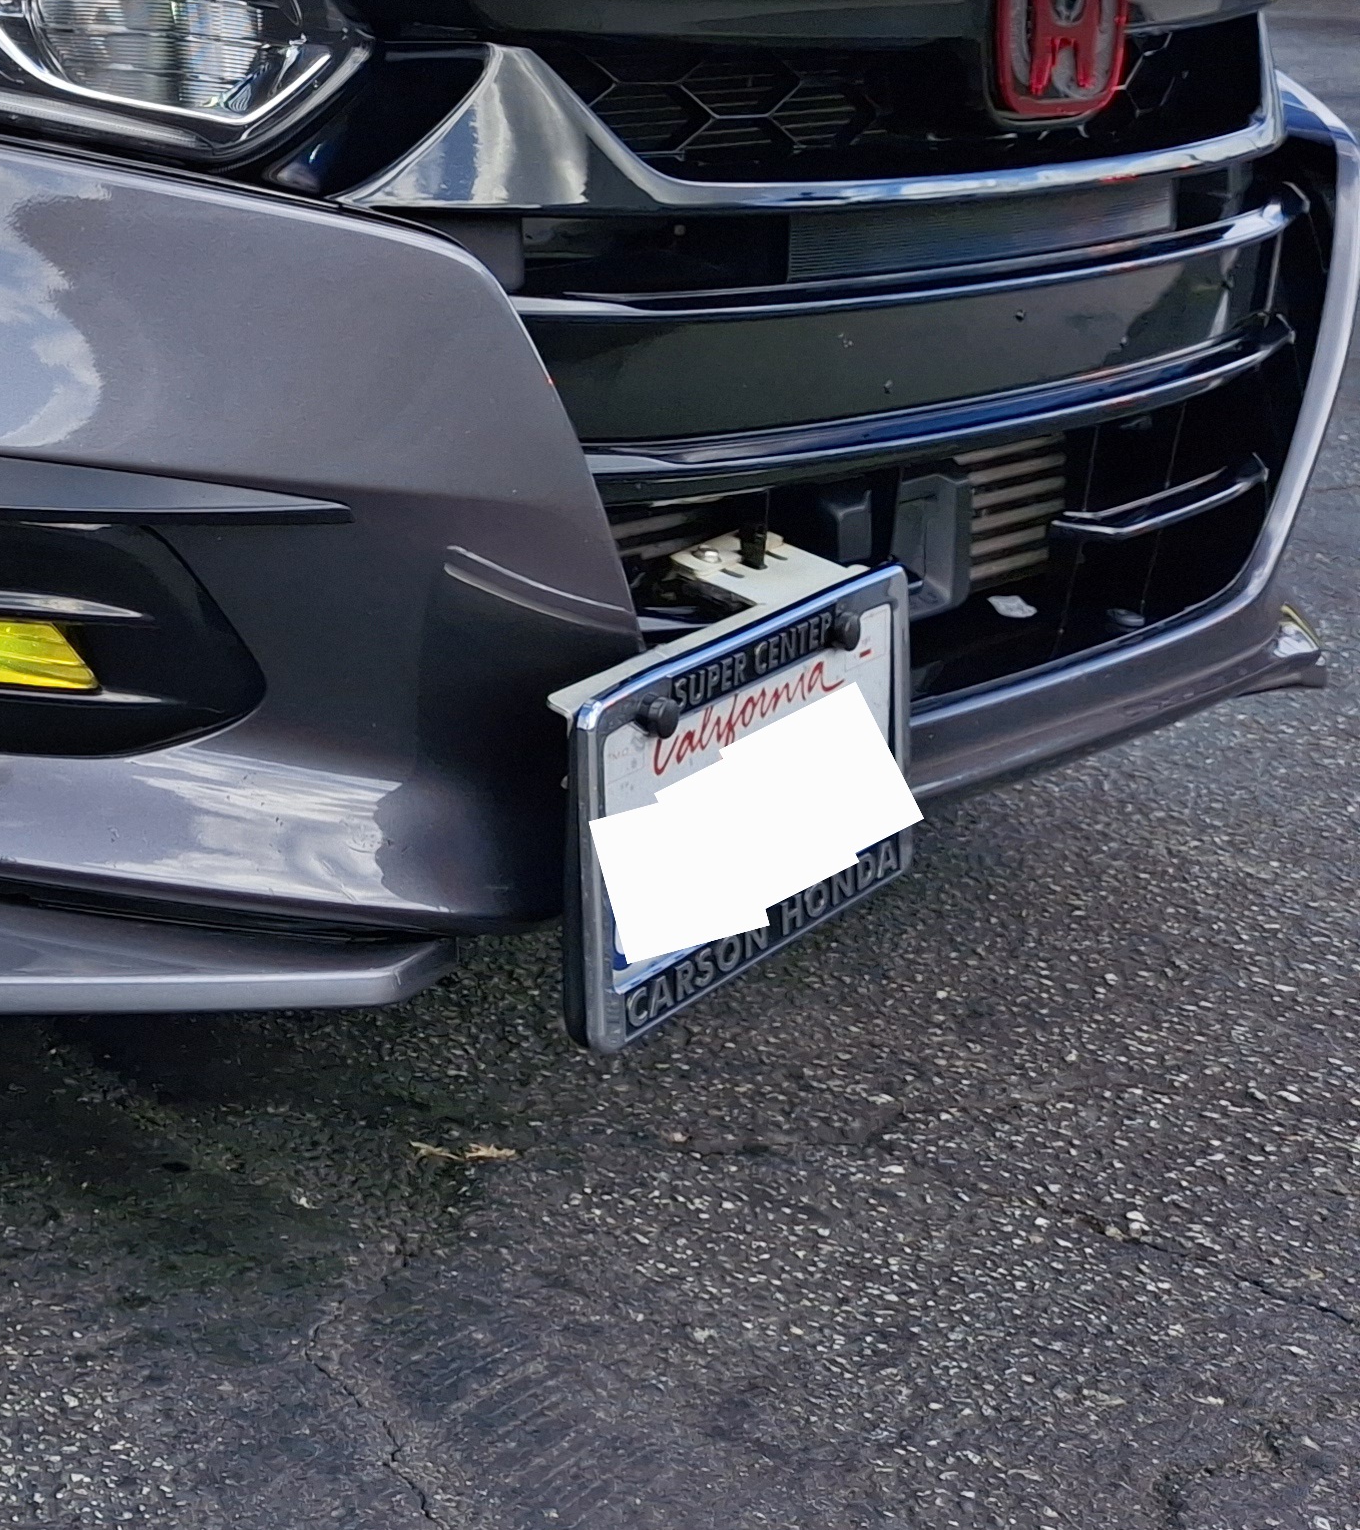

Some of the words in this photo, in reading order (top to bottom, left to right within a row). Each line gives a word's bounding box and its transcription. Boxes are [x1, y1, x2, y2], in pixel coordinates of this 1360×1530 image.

[653, 661, 845, 776] California
[673, 653, 746, 710] SUPER
[626, 929, 769, 1028] CARSON
[780, 841, 897, 936] HONDA
